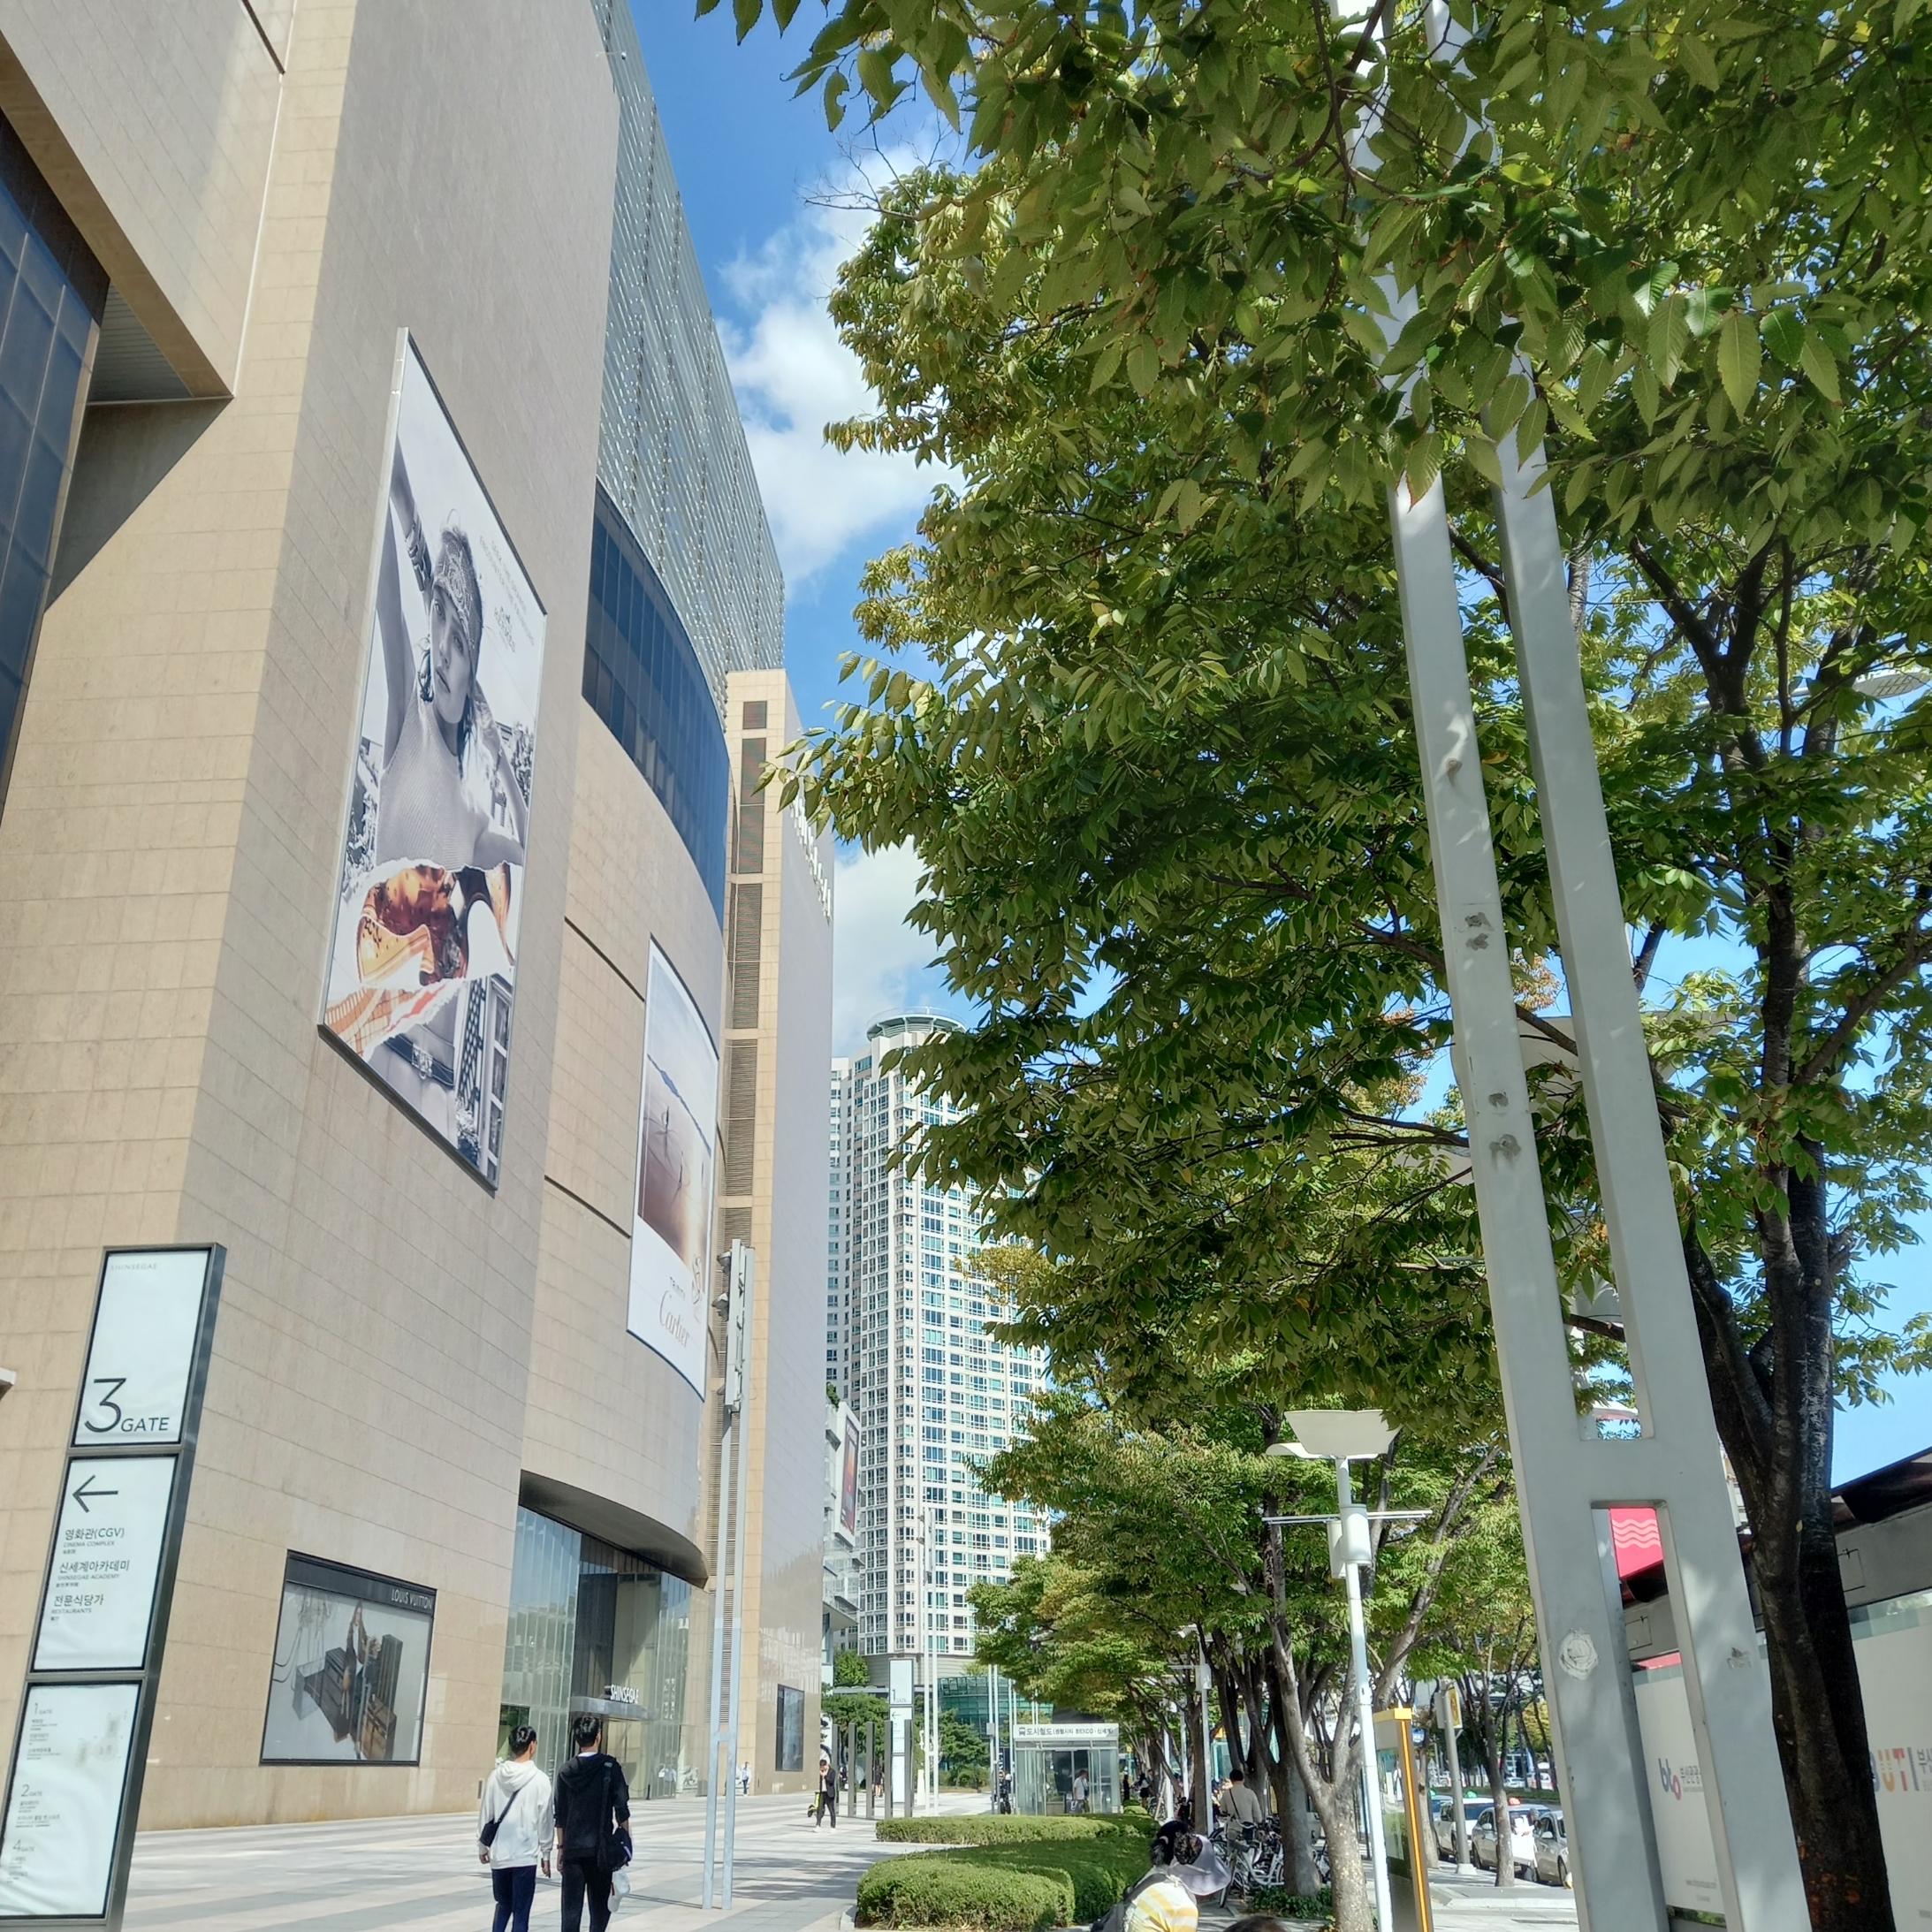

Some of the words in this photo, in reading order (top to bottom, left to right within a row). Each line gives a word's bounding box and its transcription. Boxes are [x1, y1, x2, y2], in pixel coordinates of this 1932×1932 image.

[659, 1289, 689, 1348] Cartier
[84, 1377, 127, 1433] 3
[120, 1417, 171, 1433] GATE
[65, 1527, 125, 1540] 영화관(CGV)
[59, 1560, 130, 1574] 신세계아카데미
[54, 1594, 104, 1607] 전문식당가
[391, 1588, 409, 1604] LOUIS
[409, 1594, 433, 1609] VUITTON
[610, 1684, 639, 1704] SHINSEGAE
[21, 1784, 29, 1797] 2
[12, 1839, 21, 1852] 4
